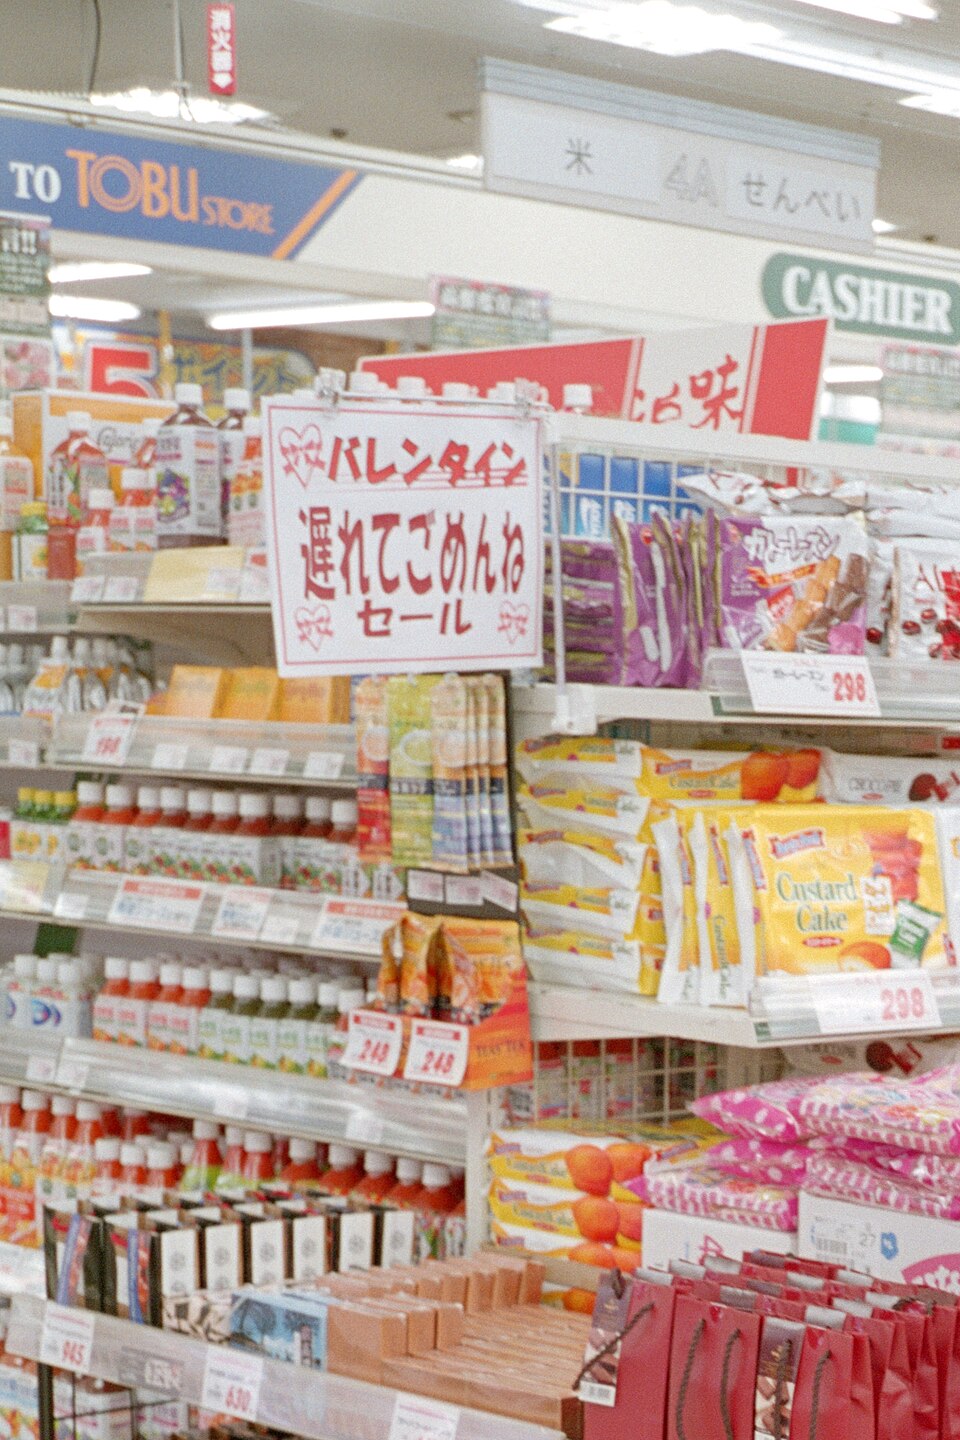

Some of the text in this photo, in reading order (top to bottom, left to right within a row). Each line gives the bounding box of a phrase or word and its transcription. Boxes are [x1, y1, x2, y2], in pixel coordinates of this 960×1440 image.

[564, 137, 595, 177] 米
[10, 149, 276, 236] TO TOBU STORE
[662, 154, 719, 208] 4A
[742, 172, 864, 224] せんべい
[780, 265, 956, 337] CASHIER
[328, 435, 528, 487] バレンタイン
[299, 506, 525, 602] 遅れてごめんね
[357, 600, 473, 638] セール
[833, 672, 867, 702] 298
[775, 872, 858, 902] Custard
[796, 904, 848, 932] Cake
[880, 987, 925, 1020] 298
[358, 1039, 389, 1064] 248
[421, 1051, 455, 1073] 248
[225, 1386, 252, 1412] 630
